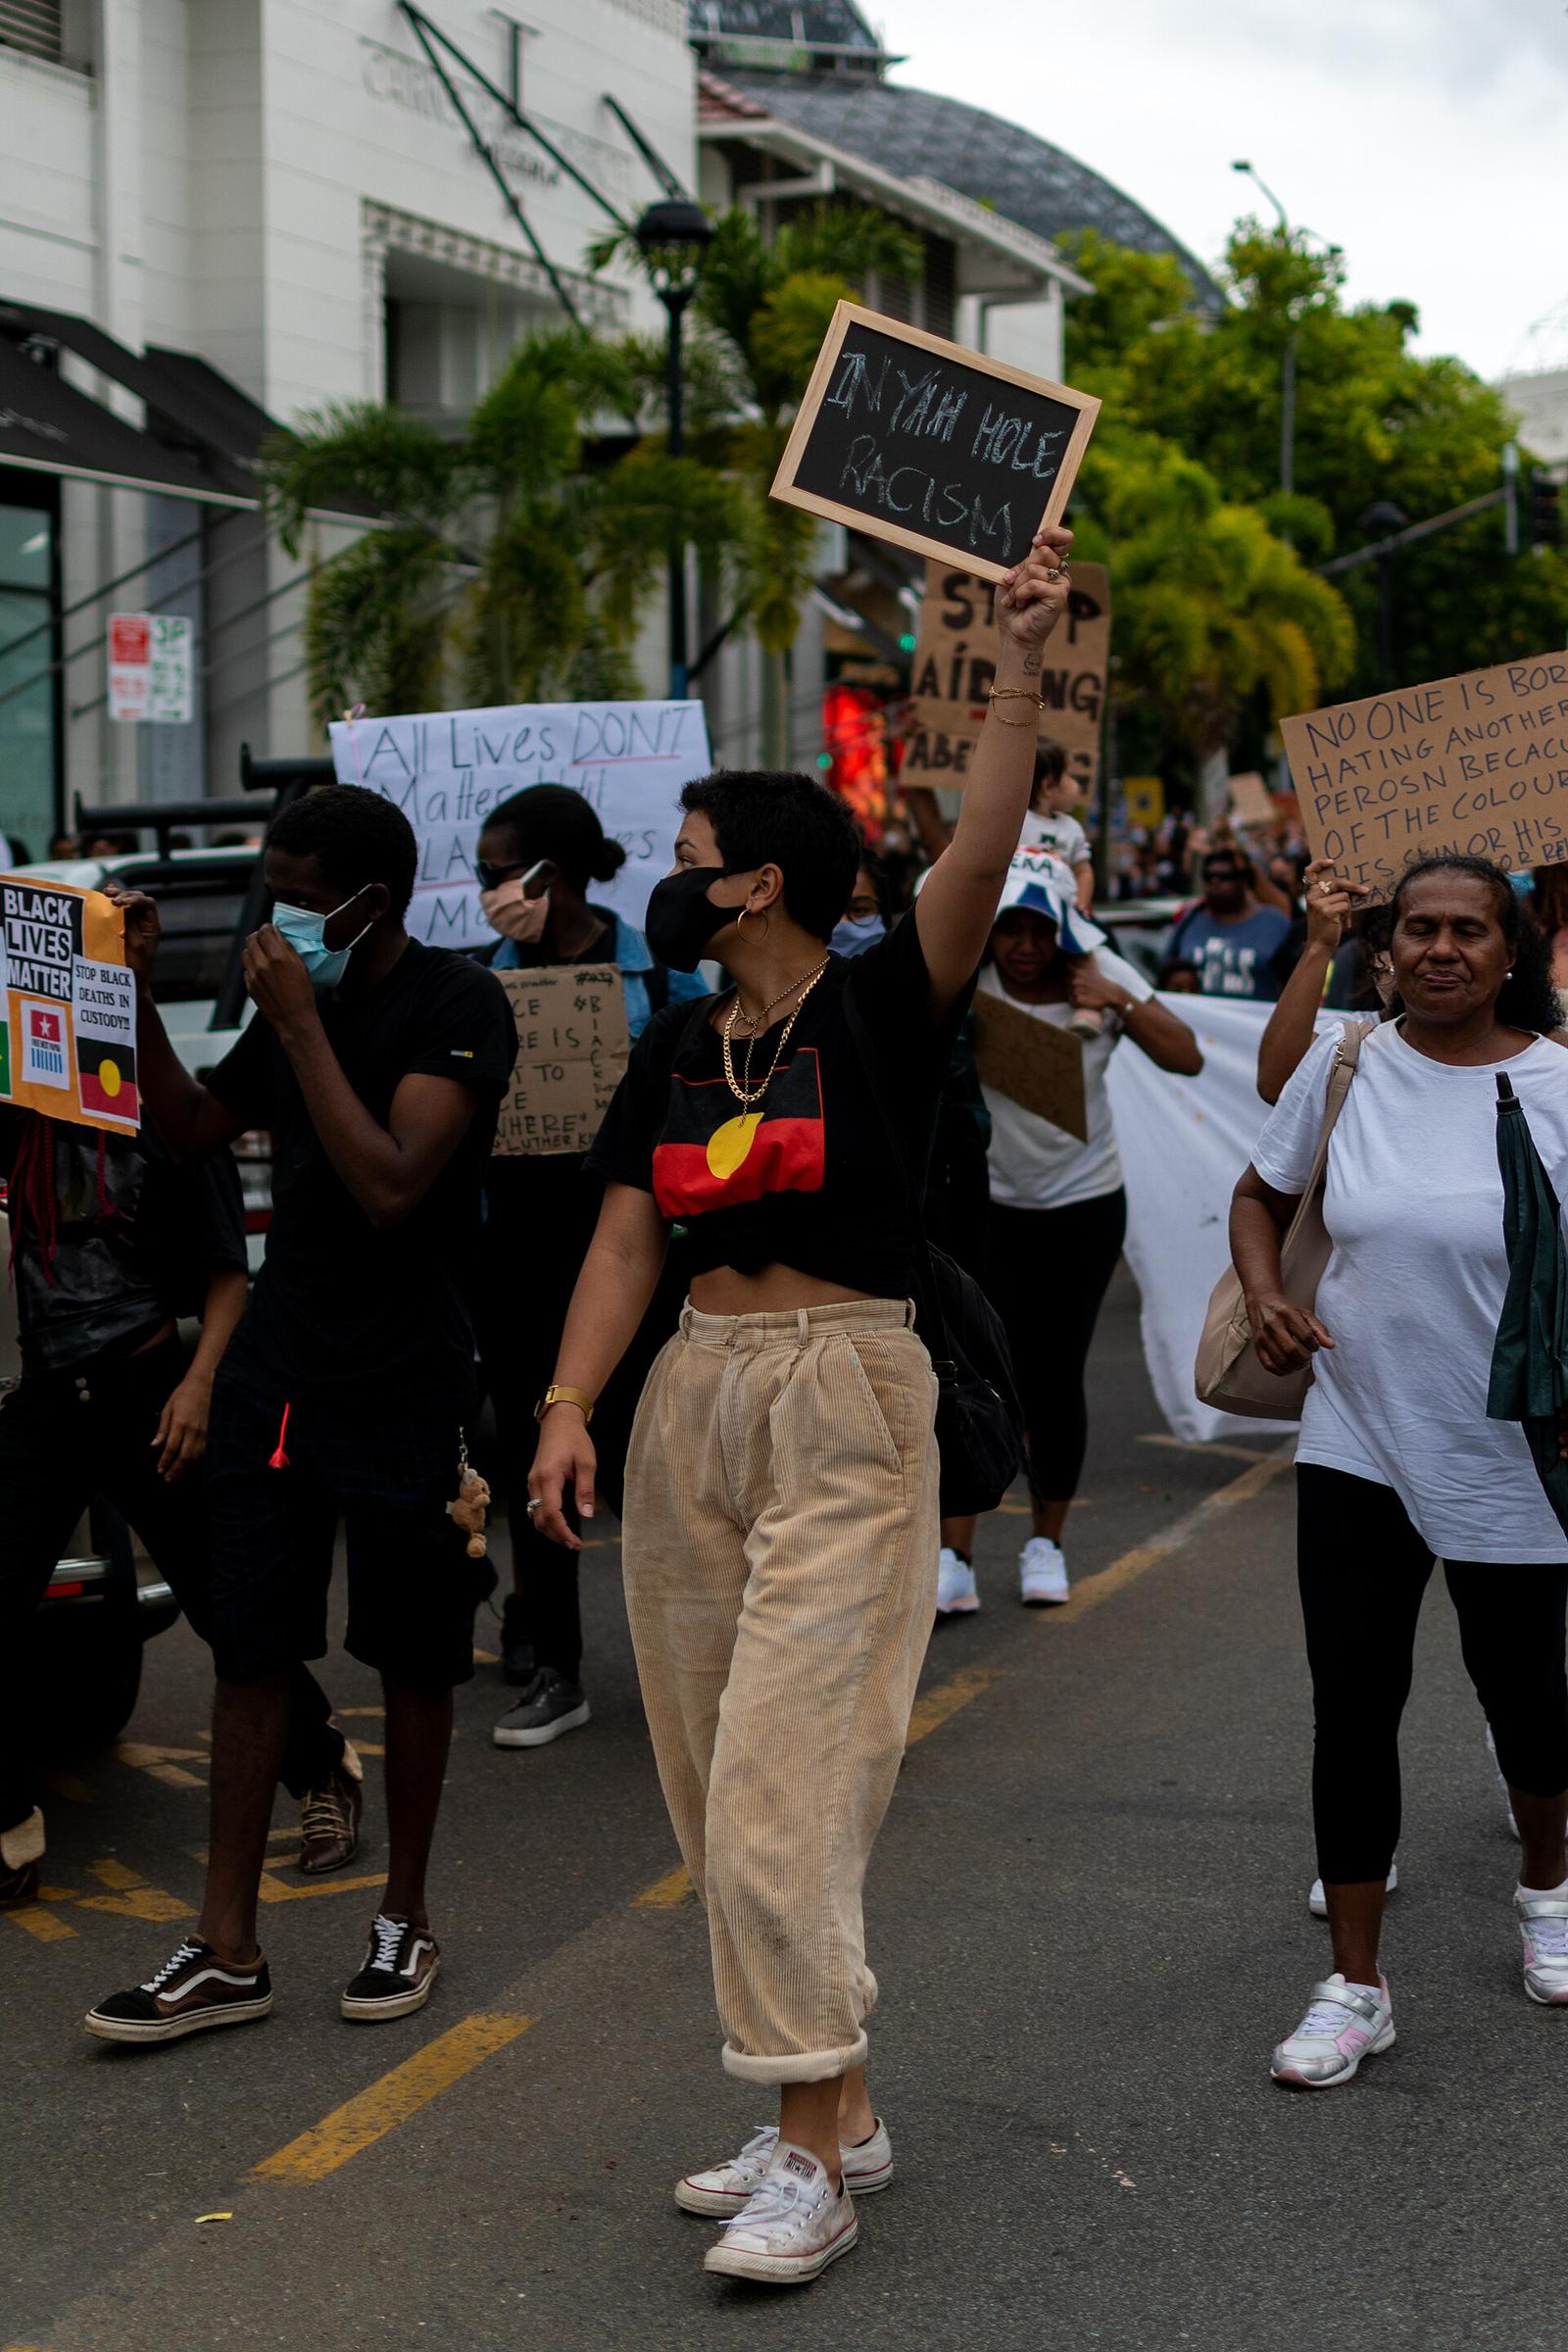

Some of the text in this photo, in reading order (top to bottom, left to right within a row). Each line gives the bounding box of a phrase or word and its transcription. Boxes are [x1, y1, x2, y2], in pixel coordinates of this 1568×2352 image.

[824, 352, 891, 419] IN
[971, 403, 1065, 478] HOLE
[839, 434, 1011, 558] RACISM
[941, 571, 1102, 646] STP
[1305, 664, 1568, 758] NO ONE IS BOR
[450, 717, 556, 769] Lives
[1307, 738, 1434, 793] HATING
[1314, 765, 1446, 825] PEROSN
[1324, 822, 1365, 860] OF
[1374, 805, 1440, 840] THE
[1466, 827, 1505, 856] OR
[1513, 817, 1562, 851] HIS
[4, 888, 74, 927] BLACK
[7, 923, 71, 962] LIVES
[7, 956, 72, 1000] MATTER
[75, 964, 131, 987] STOP BLACK
[79, 987, 130, 1008] DEATHS IN
[553, 1026, 580, 1049] IS
[533, 1063, 564, 1083] TO
[507, 1134, 571, 1152] LUTHER
